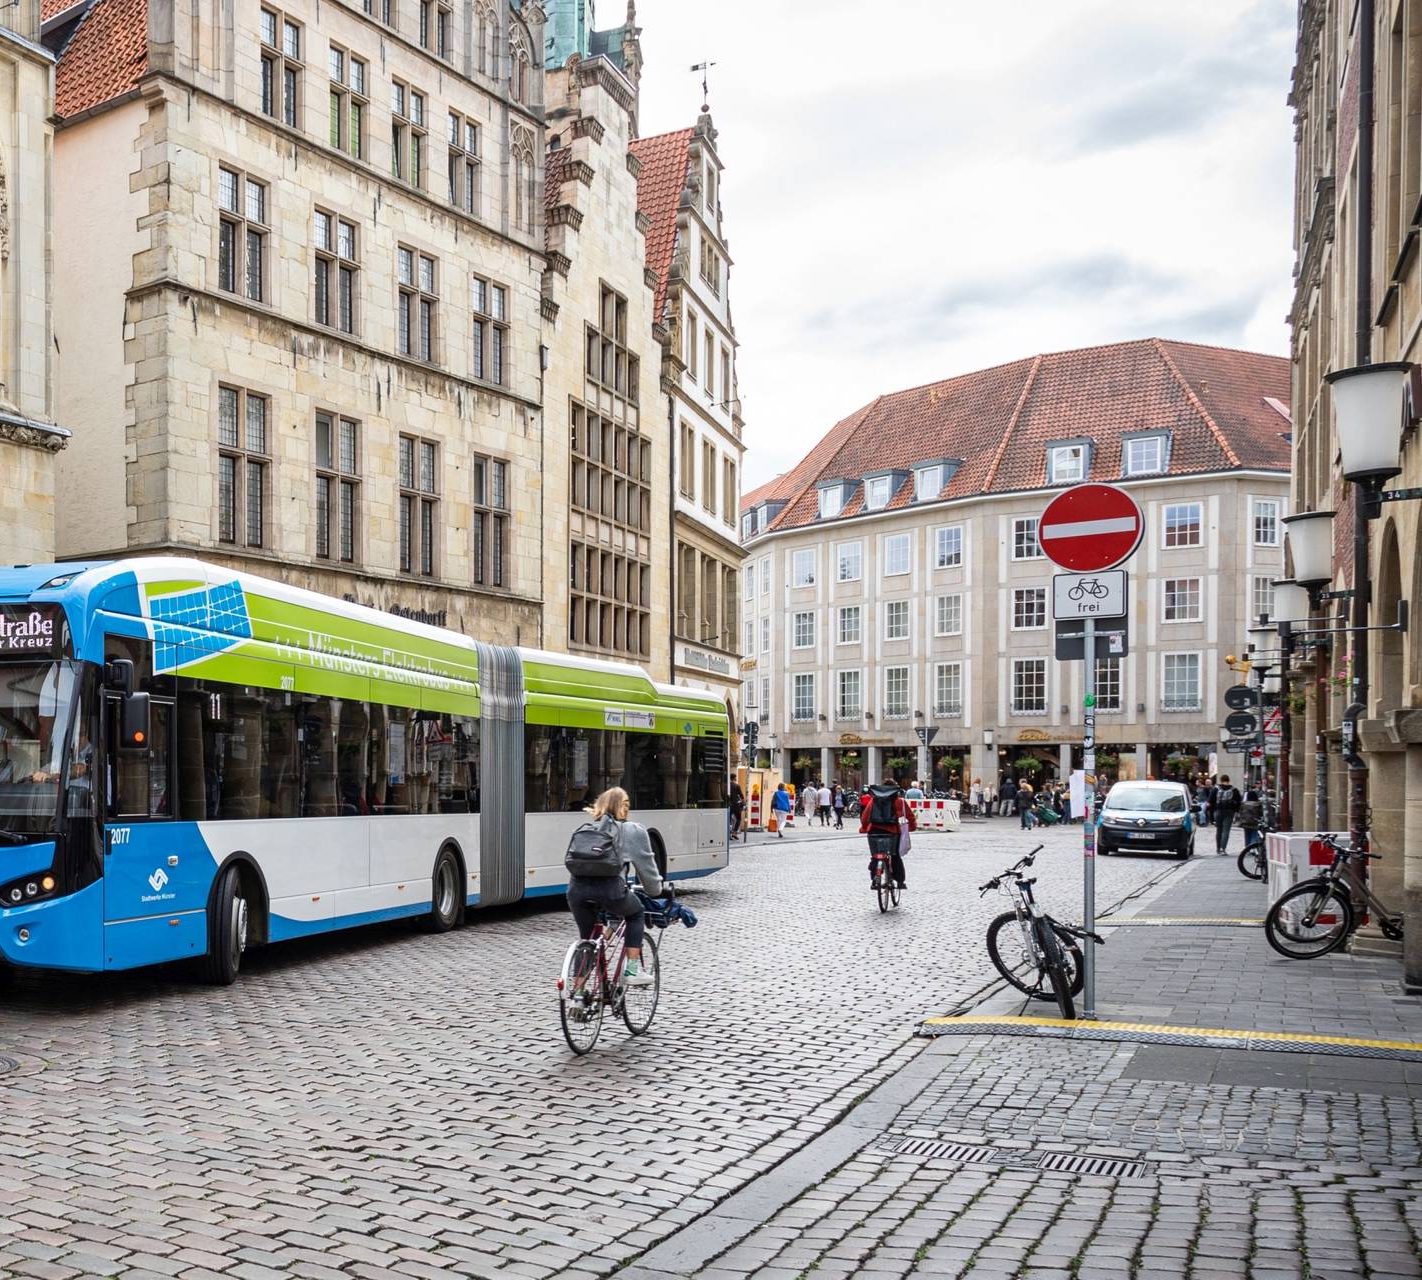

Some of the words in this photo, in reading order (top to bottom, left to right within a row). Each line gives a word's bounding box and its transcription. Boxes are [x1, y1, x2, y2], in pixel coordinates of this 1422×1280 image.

[1388, 490, 1401, 500] 34
[1077, 602, 1100, 613] frei
[9, 637, 53, 648] Kreuz
[308, 631, 380, 677] Münsters
[382, 649, 450, 690] Elektrobus
[210, 693, 221, 719] 11
[111, 828, 130, 845] 2077
[141, 894, 161, 902] Stadtwerke
